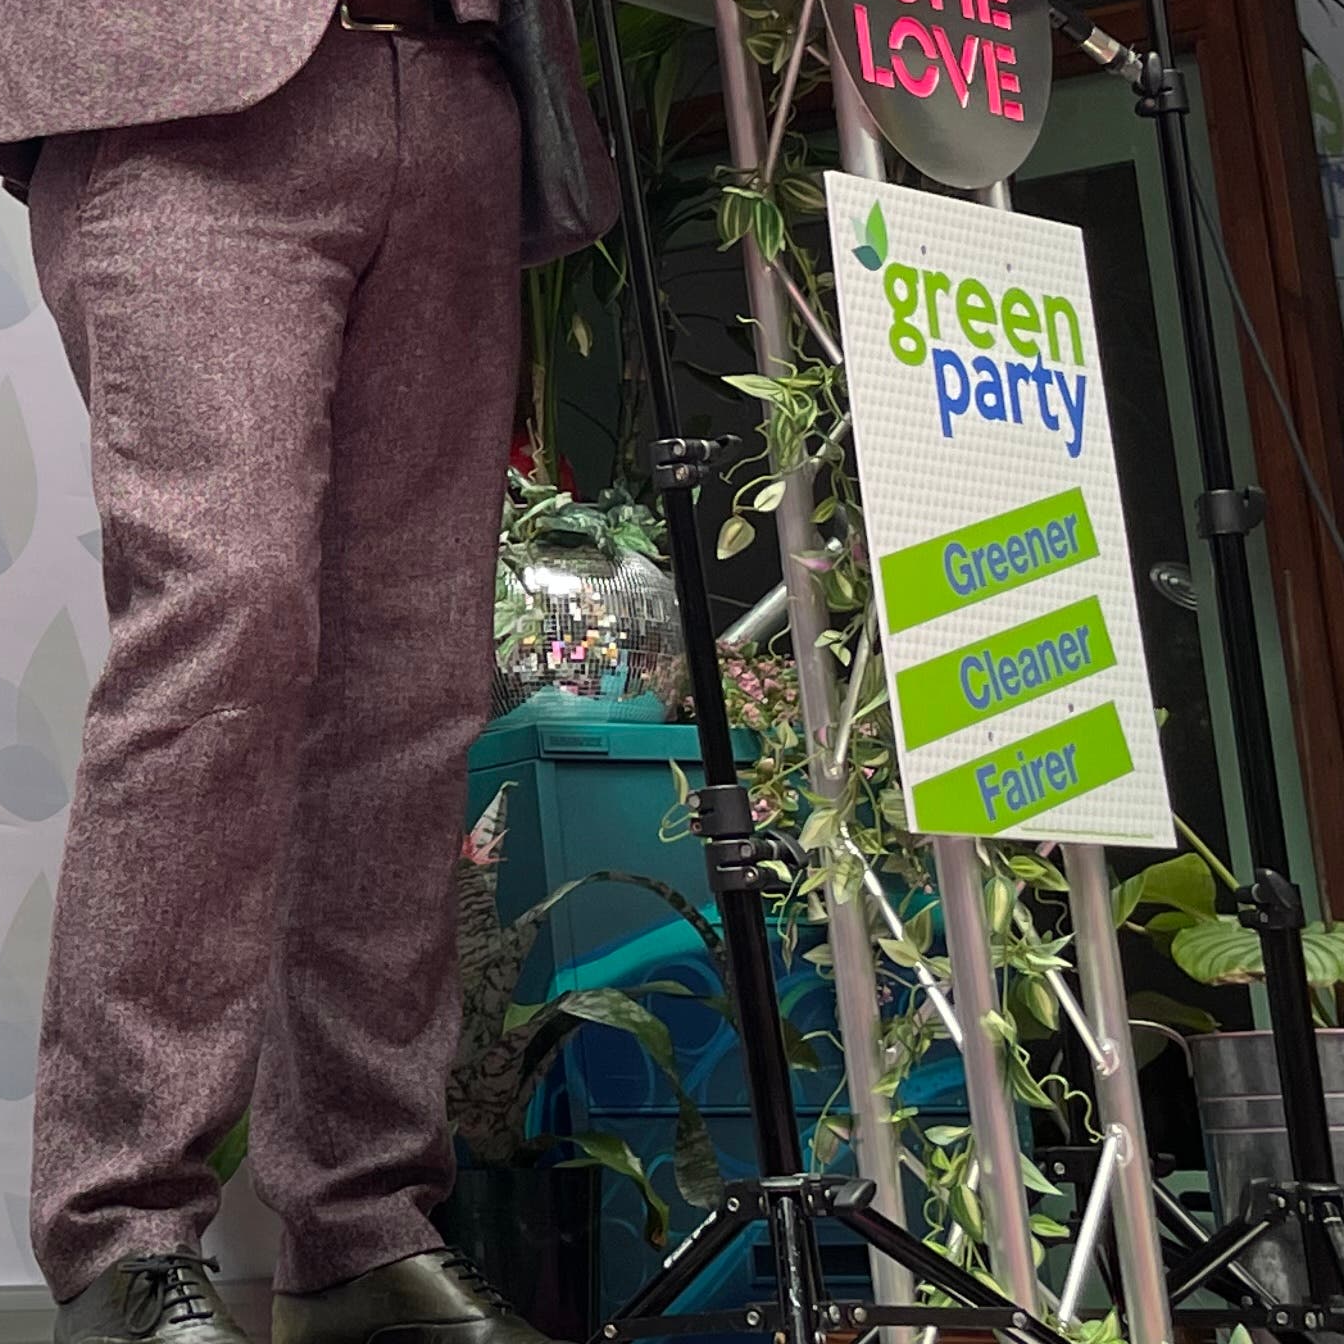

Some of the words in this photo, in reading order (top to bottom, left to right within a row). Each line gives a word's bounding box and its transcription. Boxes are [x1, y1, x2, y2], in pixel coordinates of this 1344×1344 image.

[853, 3, 1024, 122] LOVE
[883, 262, 1084, 367] green
[933, 347, 1087, 459] party
[942, 512, 1080, 598] Greener
[959, 622, 1092, 711] Cleaner
[975, 739, 1080, 822] Fairer
